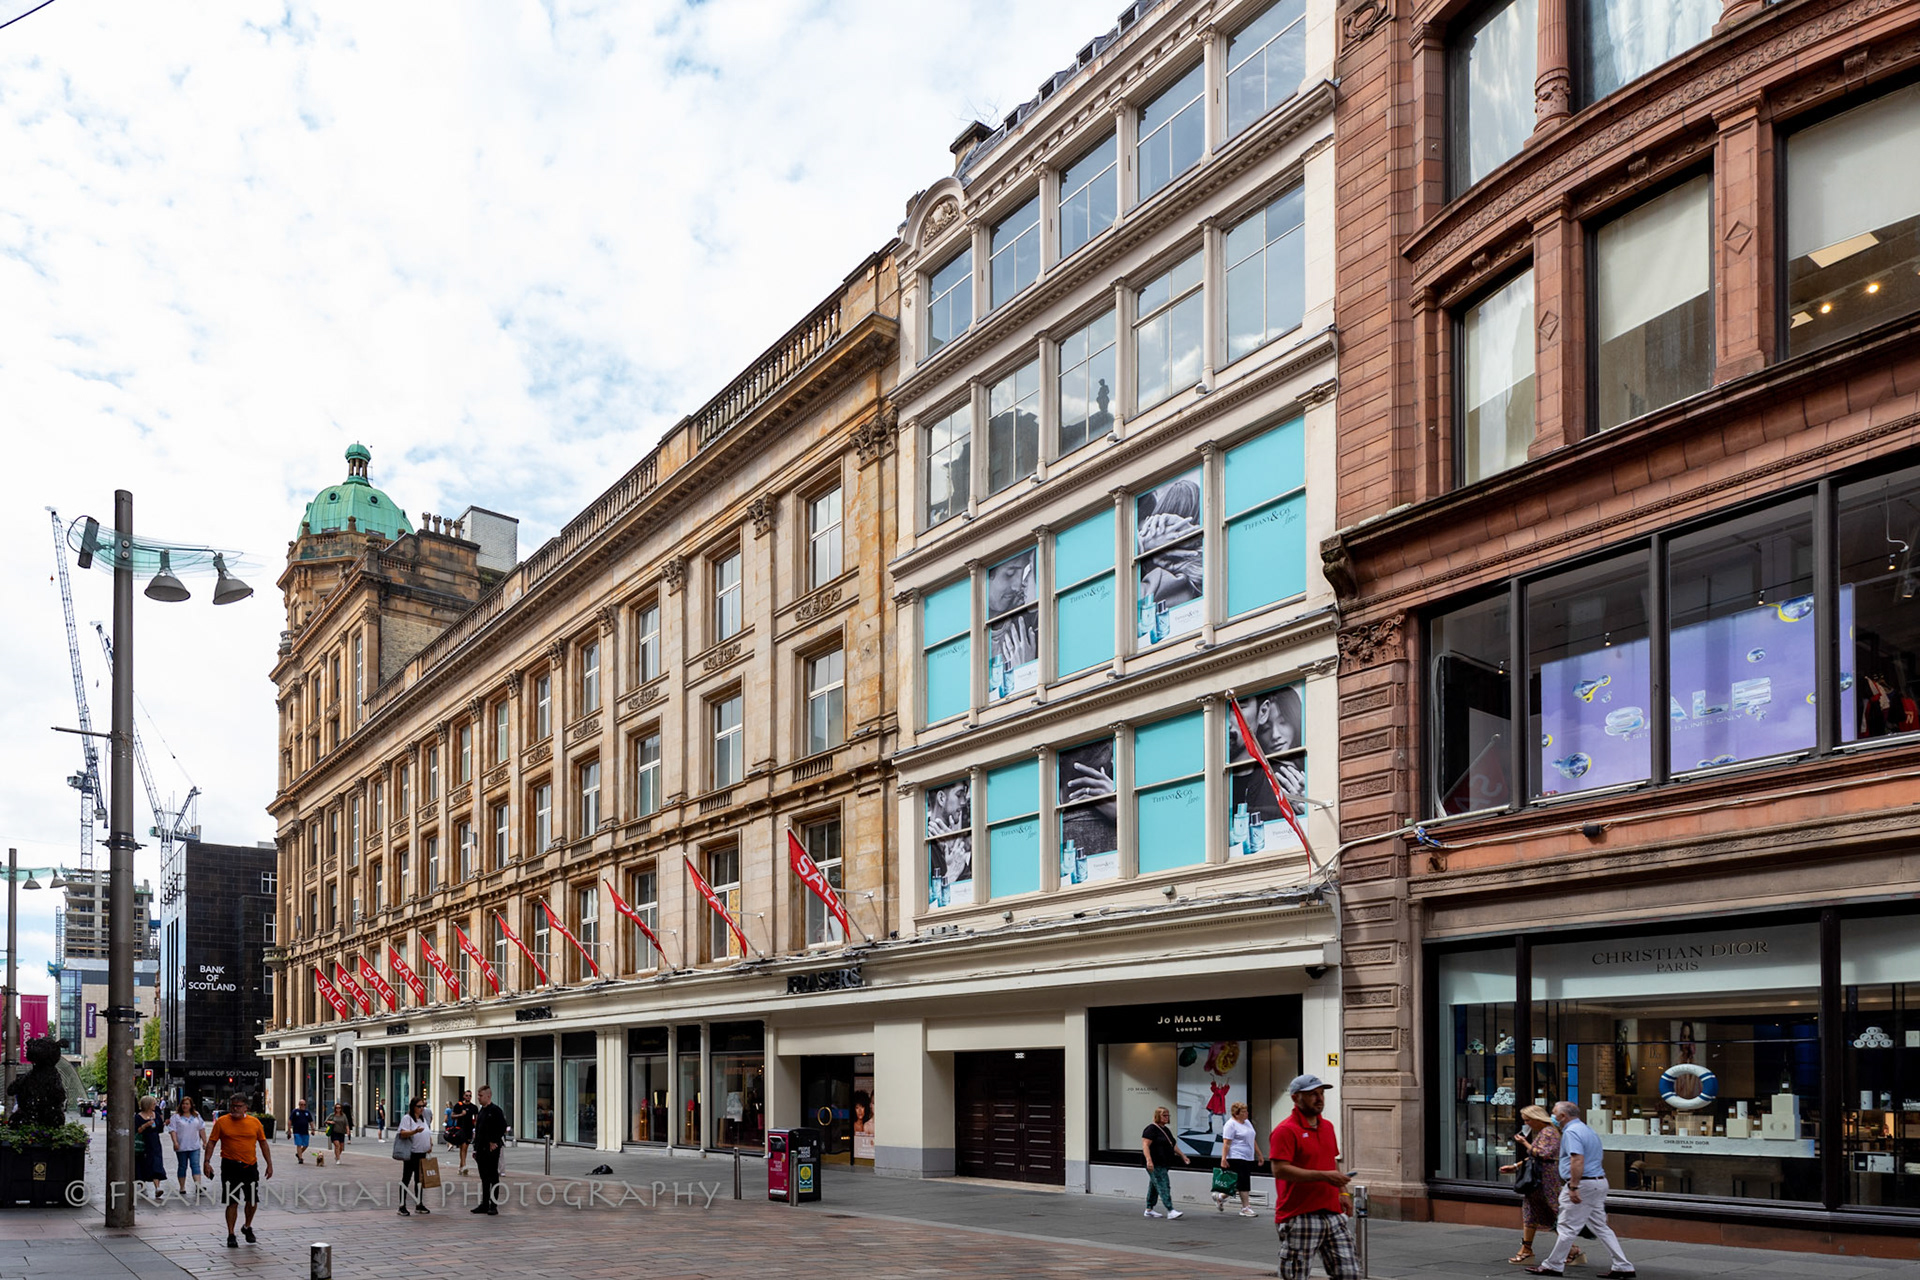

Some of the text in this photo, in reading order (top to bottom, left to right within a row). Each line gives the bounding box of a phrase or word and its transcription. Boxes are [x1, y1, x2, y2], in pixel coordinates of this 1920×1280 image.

[1716, 713, 1742, 723] ONLY
[797, 854, 847, 920] SALE
[464, 940, 495, 982] SALE
[1592, 941, 1768, 965] CHRISTIAN DIOR
[1656, 961, 1699, 973] PARIS
[200, 965, 225, 974] BANK
[206, 974, 219, 982] OF
[393, 958, 424, 996] SALE
[426, 949, 459, 989] SALE
[188, 982, 237, 992] SCOTLAND
[317, 978, 346, 1011] SALE
[339, 973, 369, 1006] SALE
[363, 966, 395, 1001] SALE
[1215, 1179, 1228, 1188] M&S
